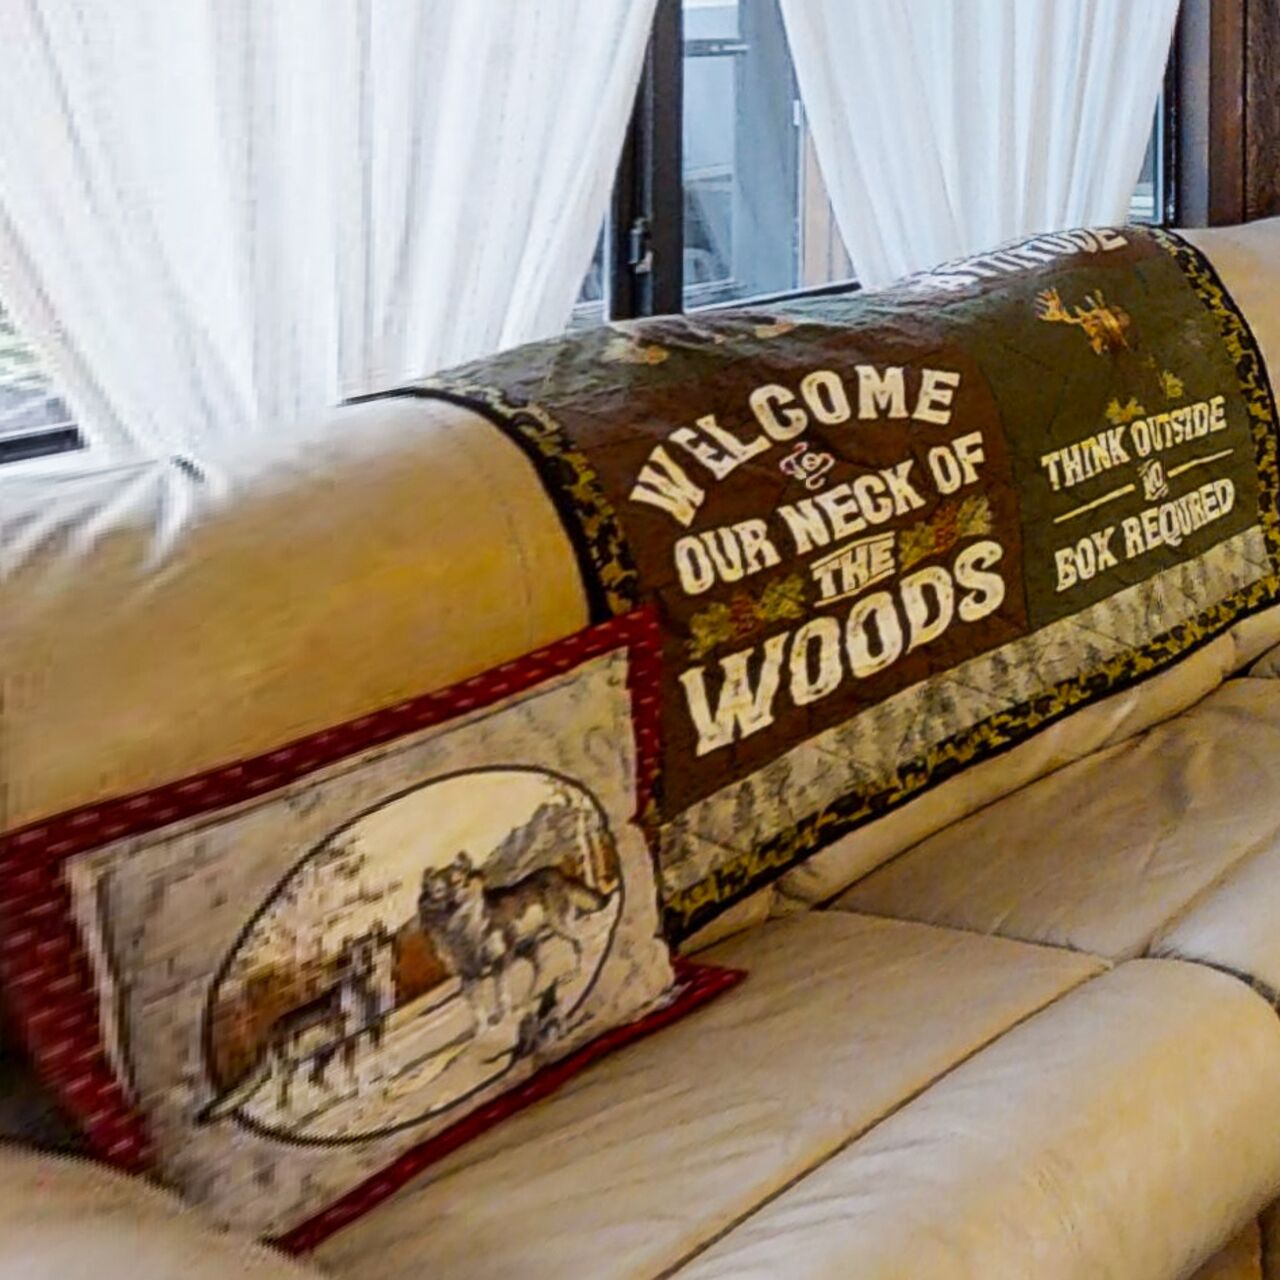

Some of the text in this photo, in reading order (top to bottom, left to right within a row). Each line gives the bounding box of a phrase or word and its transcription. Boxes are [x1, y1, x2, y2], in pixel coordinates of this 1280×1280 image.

[630, 365, 962, 528] WELCOME
[1041, 395, 1227, 491] THINK OUTSIDE
[673, 431, 985, 595] OUR NECK OF
[812, 537, 896, 599] THE
[1054, 526, 1119, 592] BOX
[678, 540, 1005, 756] WOODS
